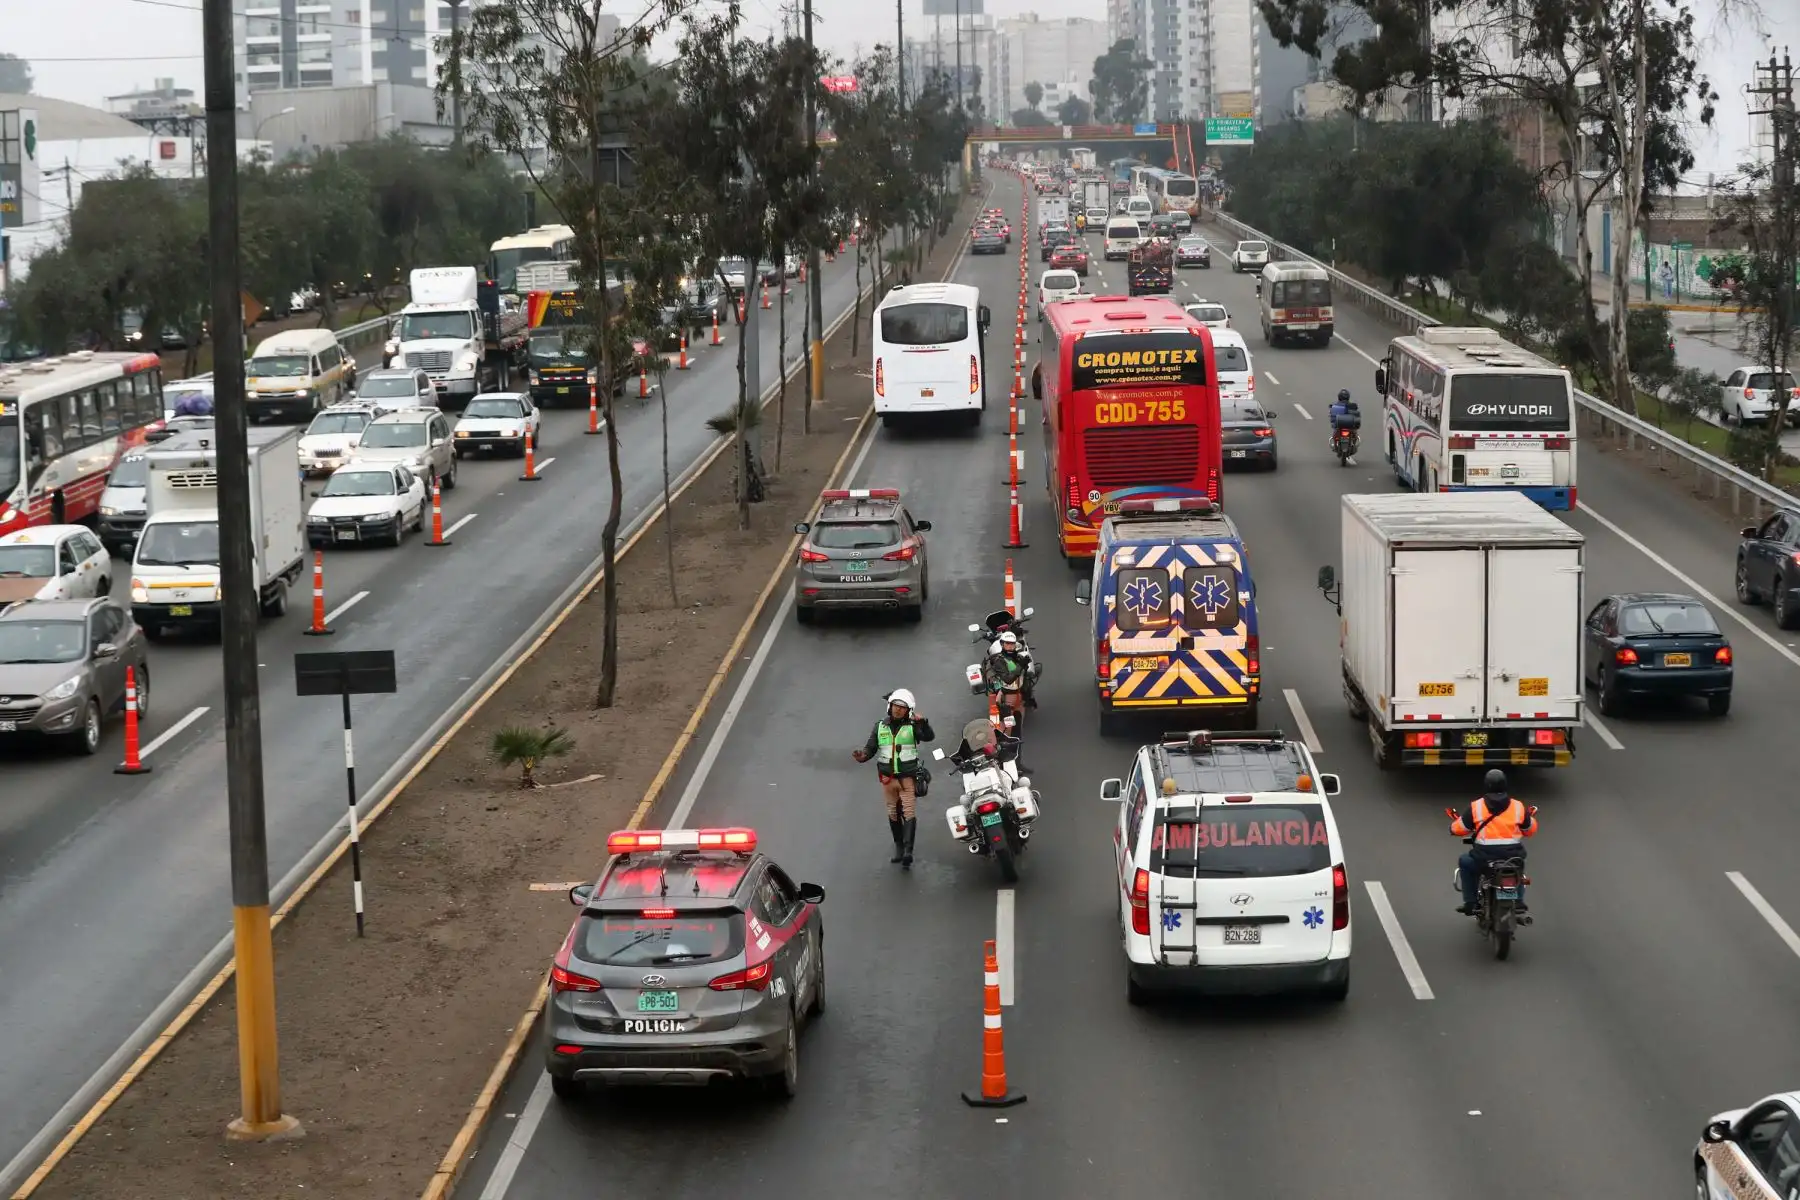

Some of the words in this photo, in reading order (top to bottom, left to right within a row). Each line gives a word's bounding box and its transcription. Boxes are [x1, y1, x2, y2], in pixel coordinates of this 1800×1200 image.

[1078, 350, 1198, 368] CROMOTEX
[1126, 366, 1135, 374] tu
[1136, 365, 1160, 374] pasaje
[1095, 374, 1182, 384] www.cromotex.com.pe
[1095, 400, 1186, 424] CDD-755
[1488, 405, 1552, 415] HYUNDAI
[1419, 683, 1453, 695] ACJ-756
[1152, 821, 1329, 850] AMBULANCIA
[645, 996, 676, 1008] PB-501
[624, 1020, 685, 1033] POLICIA
